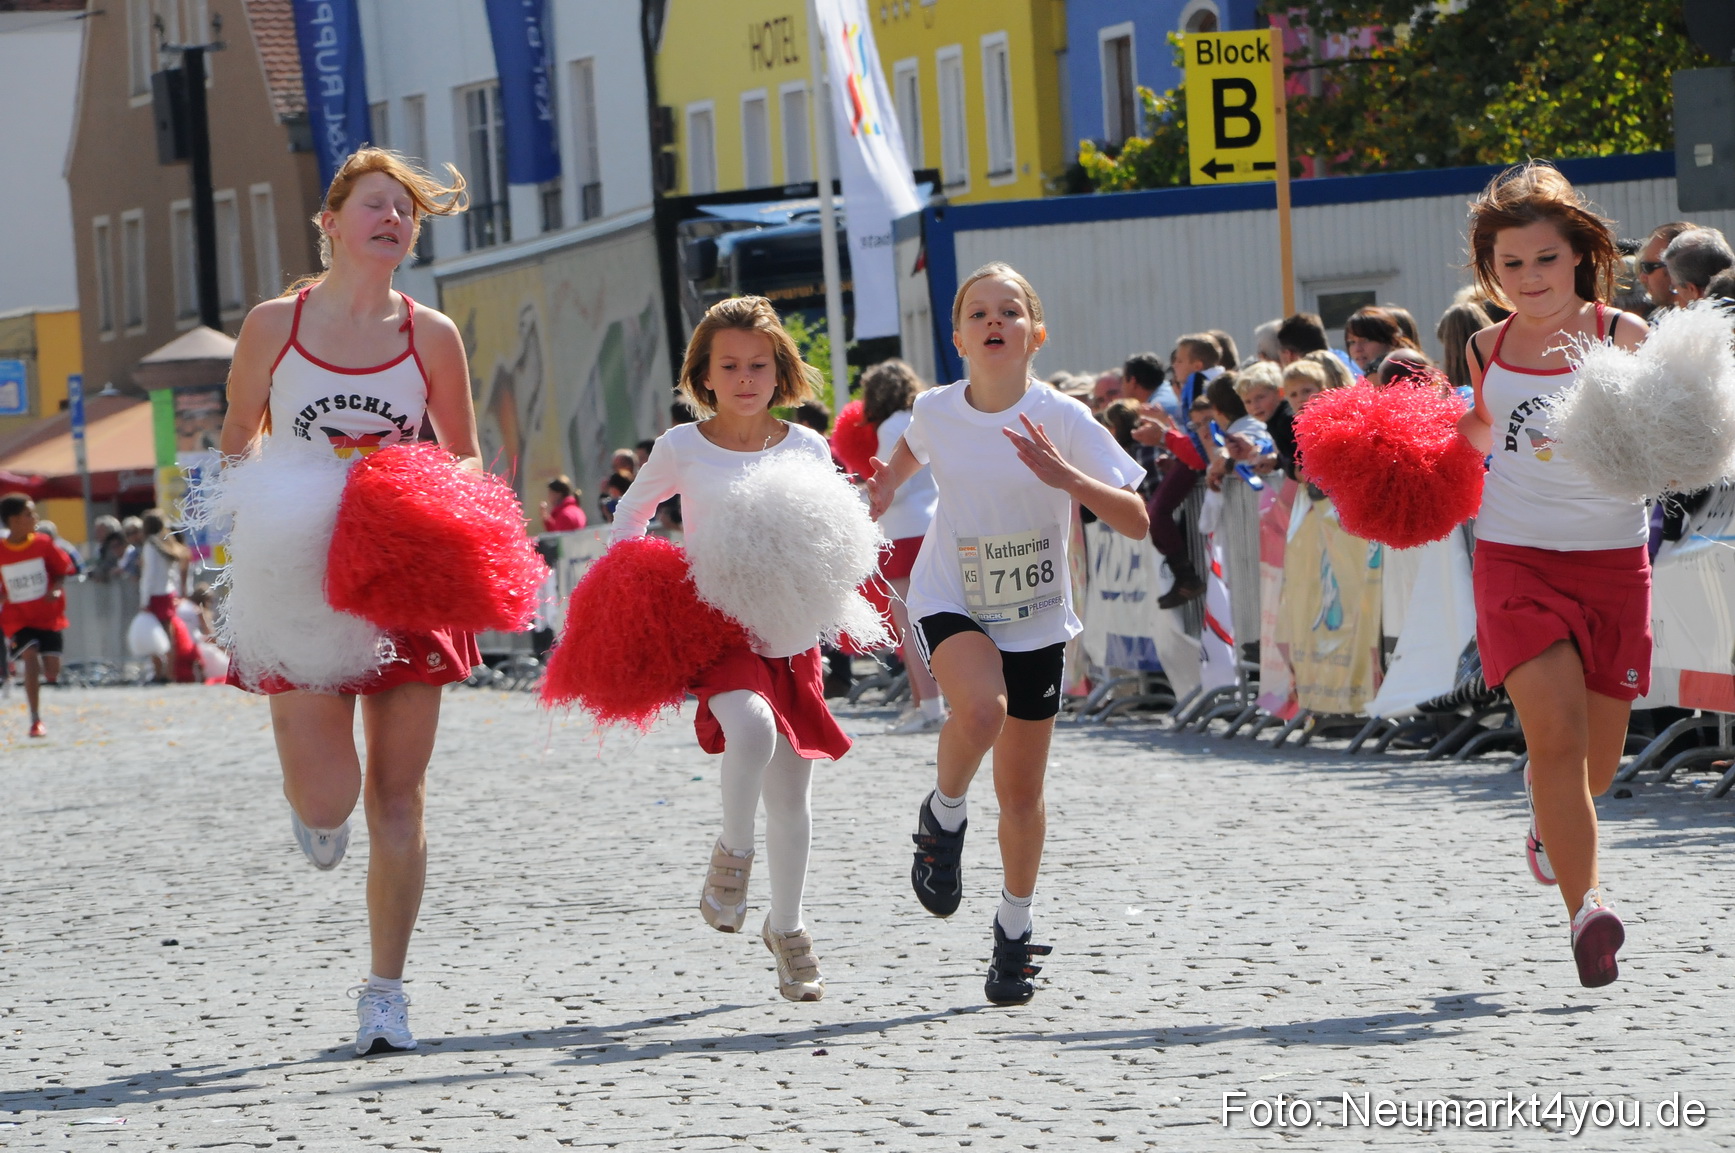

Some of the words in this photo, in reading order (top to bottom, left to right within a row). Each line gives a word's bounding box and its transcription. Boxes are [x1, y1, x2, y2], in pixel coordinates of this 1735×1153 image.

[748, 14, 799, 73] HOTEL
[1196, 37, 1271, 65] Block
[1212, 77, 1262, 149] B
[292, 394, 415, 442] DEUTSCHLAN
[1504, 395, 1551, 452] DEUTS
[985, 538, 1050, 560] Katharina
[964, 570, 978, 583] K5
[990, 559, 1055, 594] 7168
